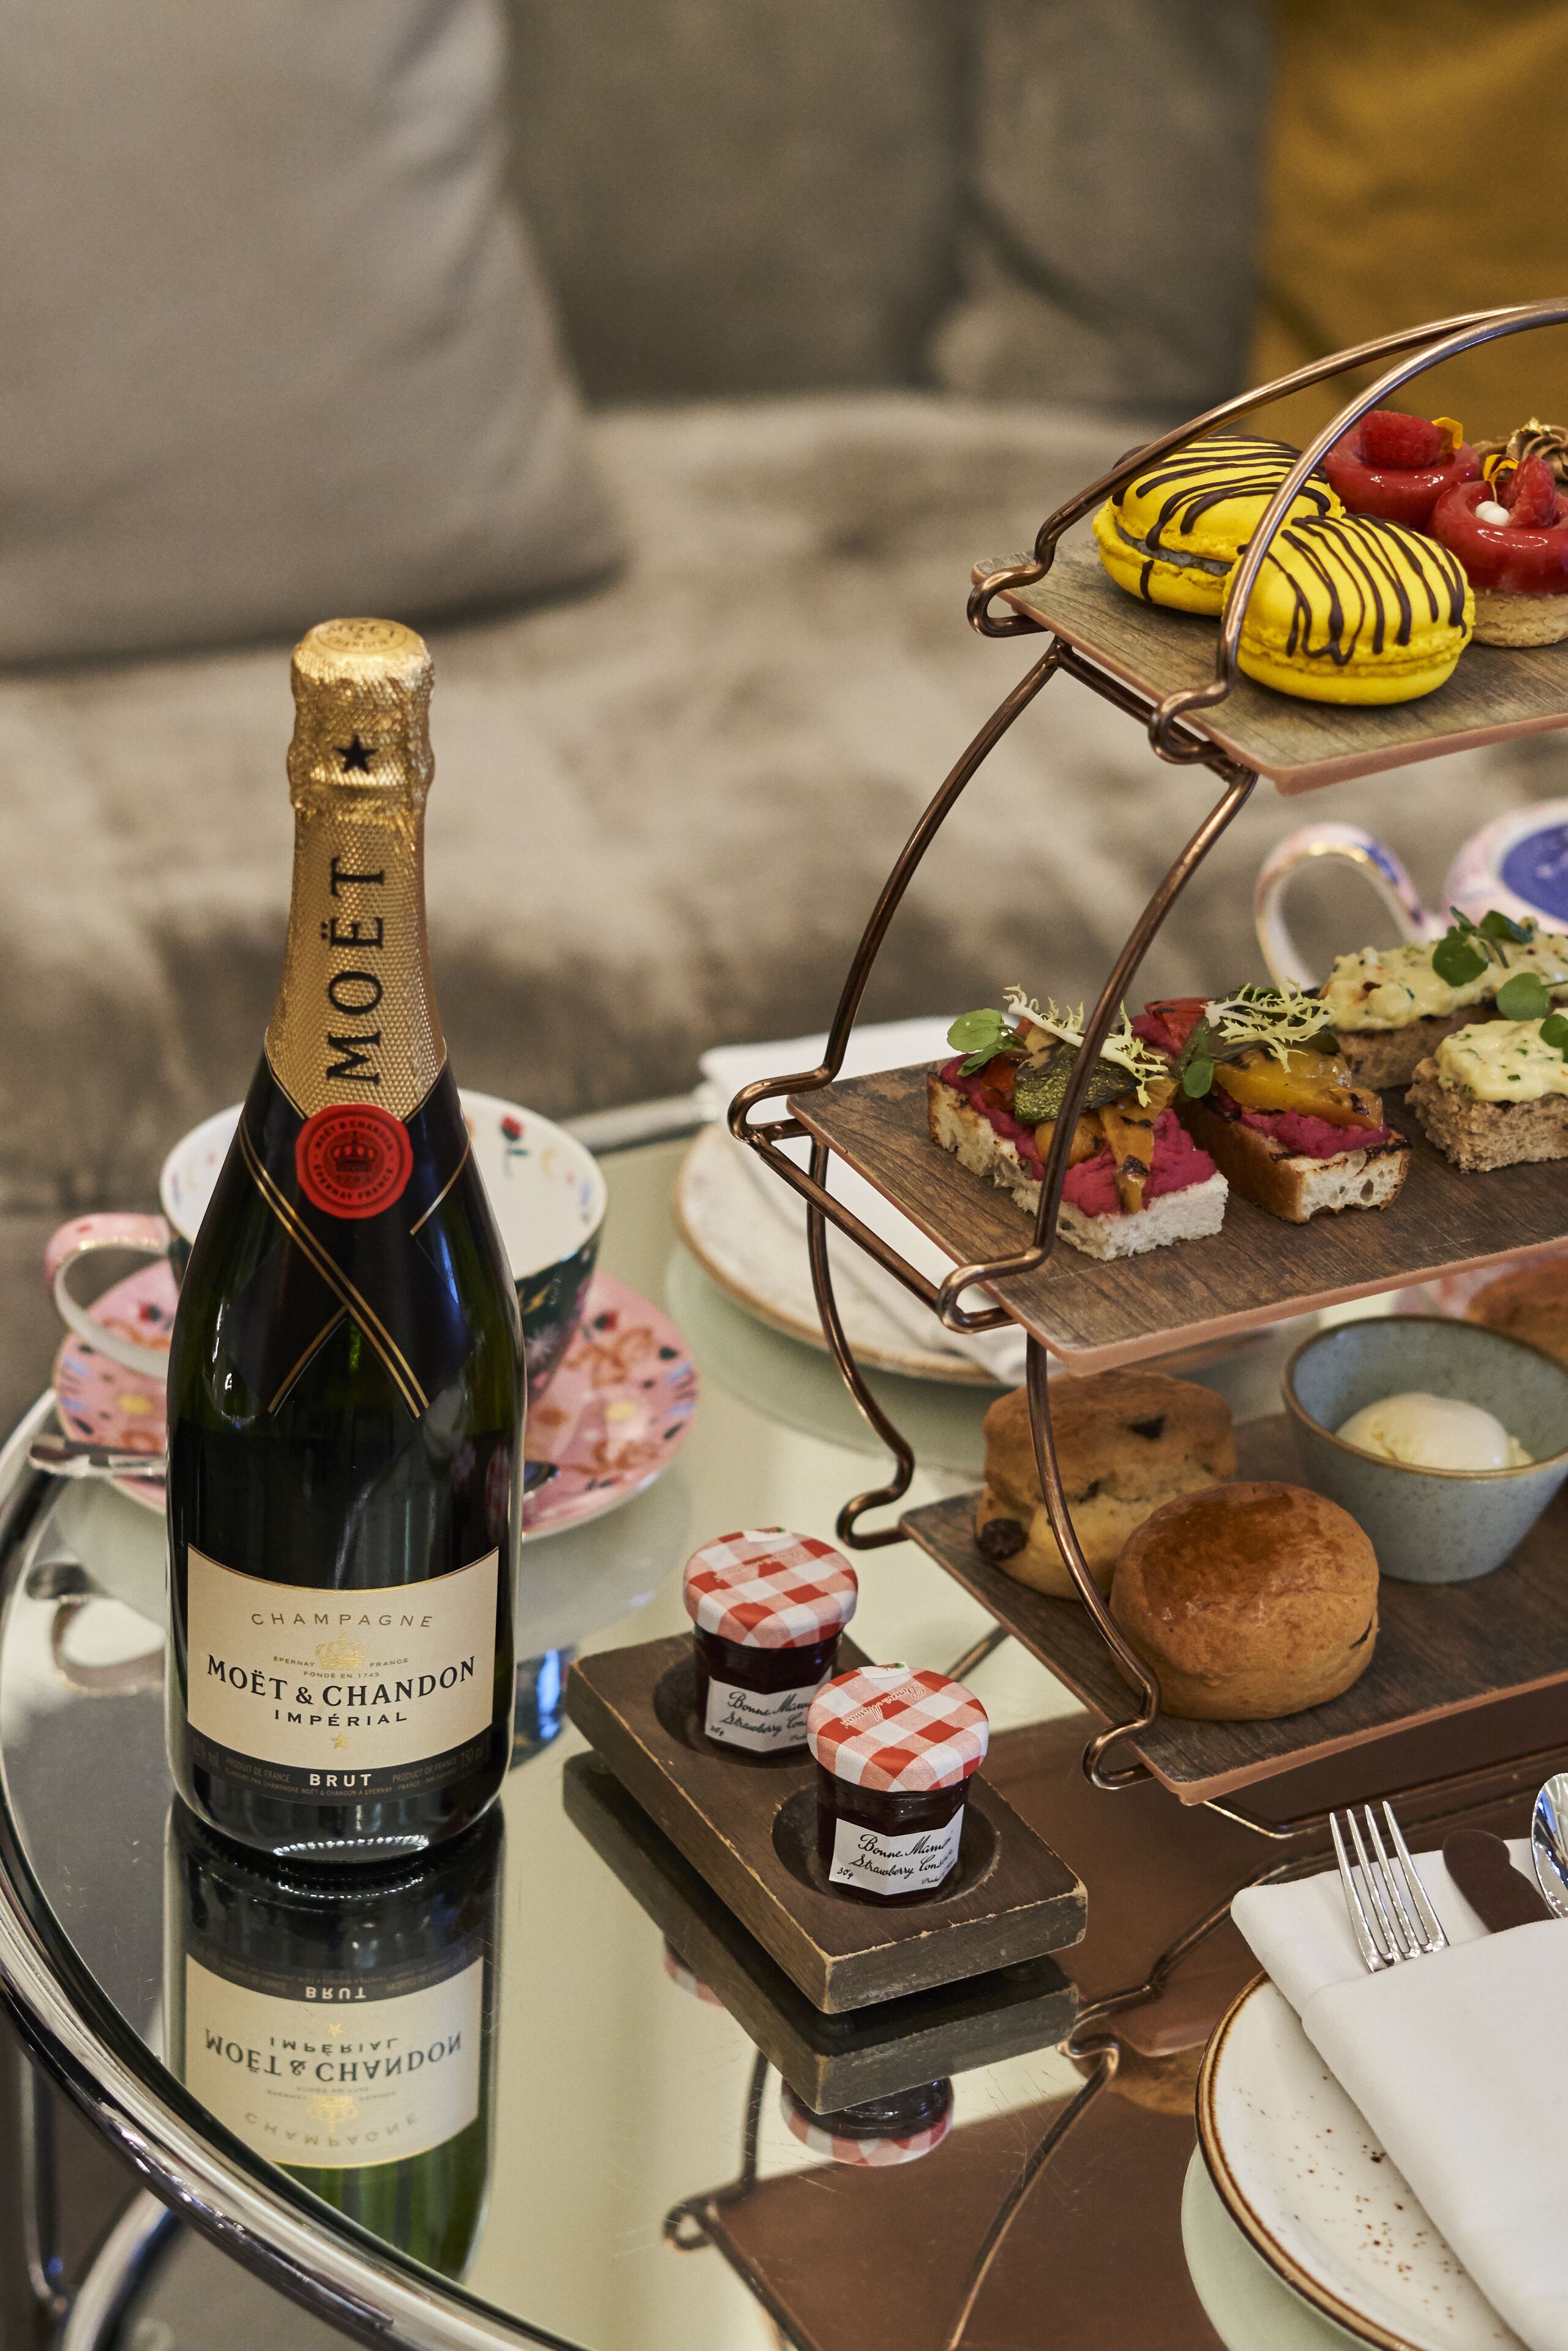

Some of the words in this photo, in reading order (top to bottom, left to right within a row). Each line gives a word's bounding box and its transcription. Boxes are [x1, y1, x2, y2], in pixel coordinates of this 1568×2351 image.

[321, 857, 384, 1086] MOËT
[252, 1613, 432, 1628] CHAMPAGNE
[370, 1658, 408, 1667] FRANCE
[207, 1654, 288, 1700] MOËT
[296, 1687, 314, 1704] &
[322, 1655, 475, 1706] CHANDON
[727, 1691, 771, 1715] Bonne
[275, 1709, 407, 1726] IMPÉRIAL
[253, 1766, 263, 1775] DE
[264, 1769, 290, 1783] FRANCE
[310, 1774, 372, 1787] BRUT
[392, 1768, 423, 1783] PRODUCT
[858, 1834, 903, 1858] Bonne
[836, 1867, 854, 1880] 30g
[849, 1854, 915, 1880] Strawberry
